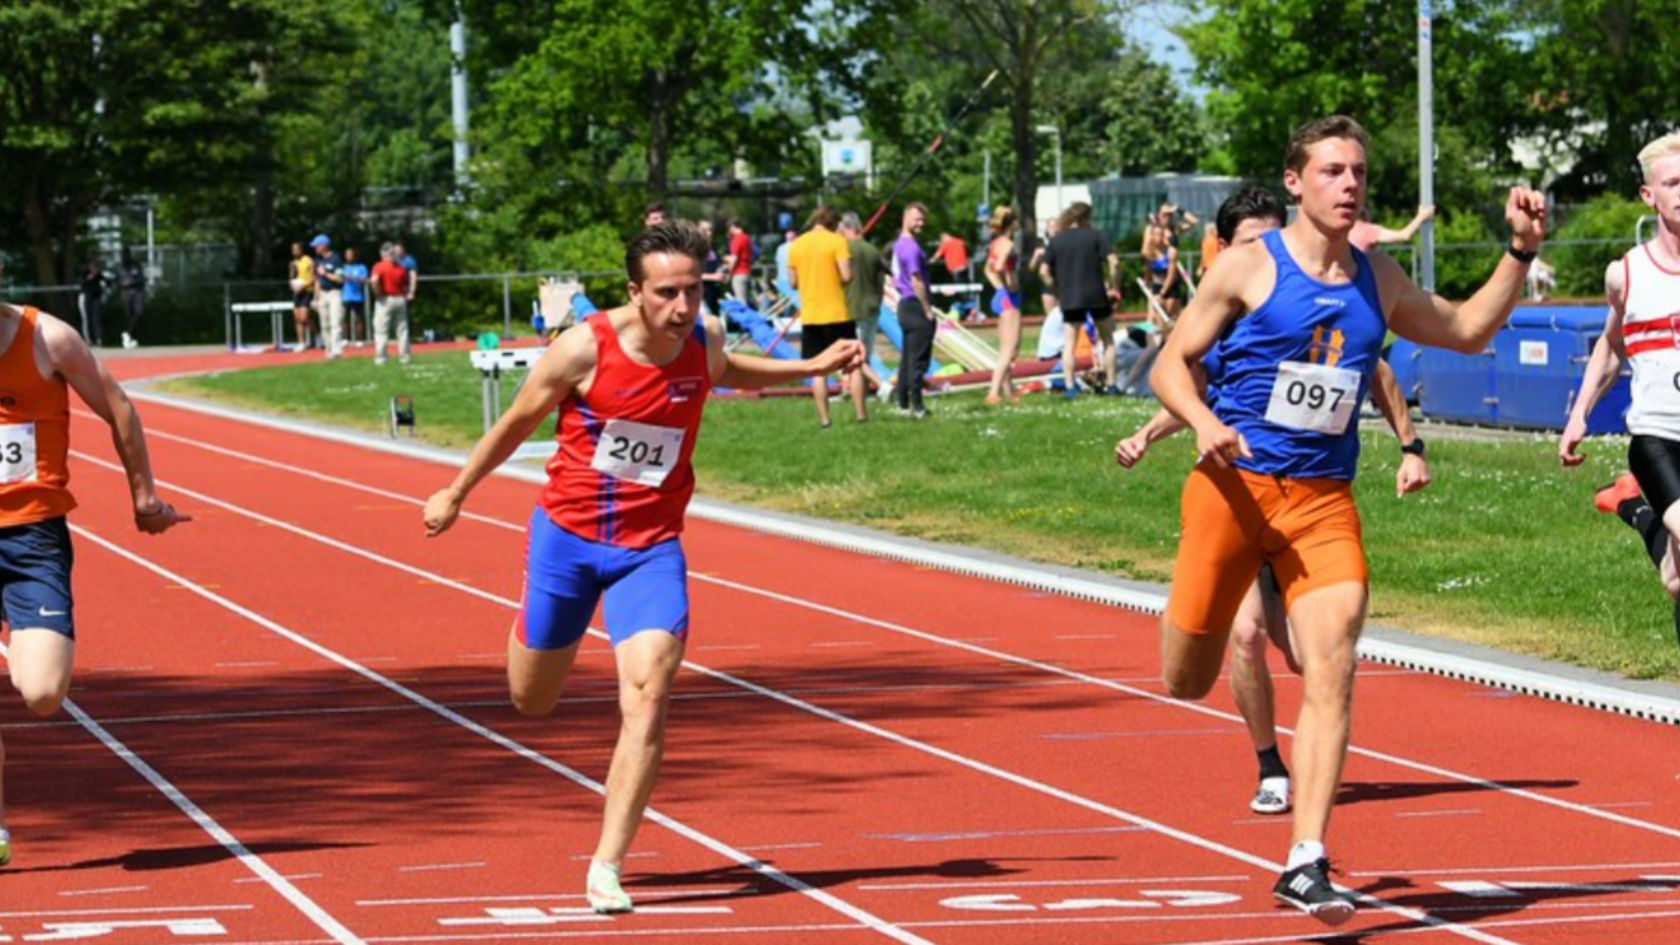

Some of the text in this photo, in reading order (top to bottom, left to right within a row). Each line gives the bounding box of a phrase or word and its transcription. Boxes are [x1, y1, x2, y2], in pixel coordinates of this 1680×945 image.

[1287, 380, 1345, 413] 097
[0, 441, 22, 464] 3
[609, 436, 664, 467] 201
